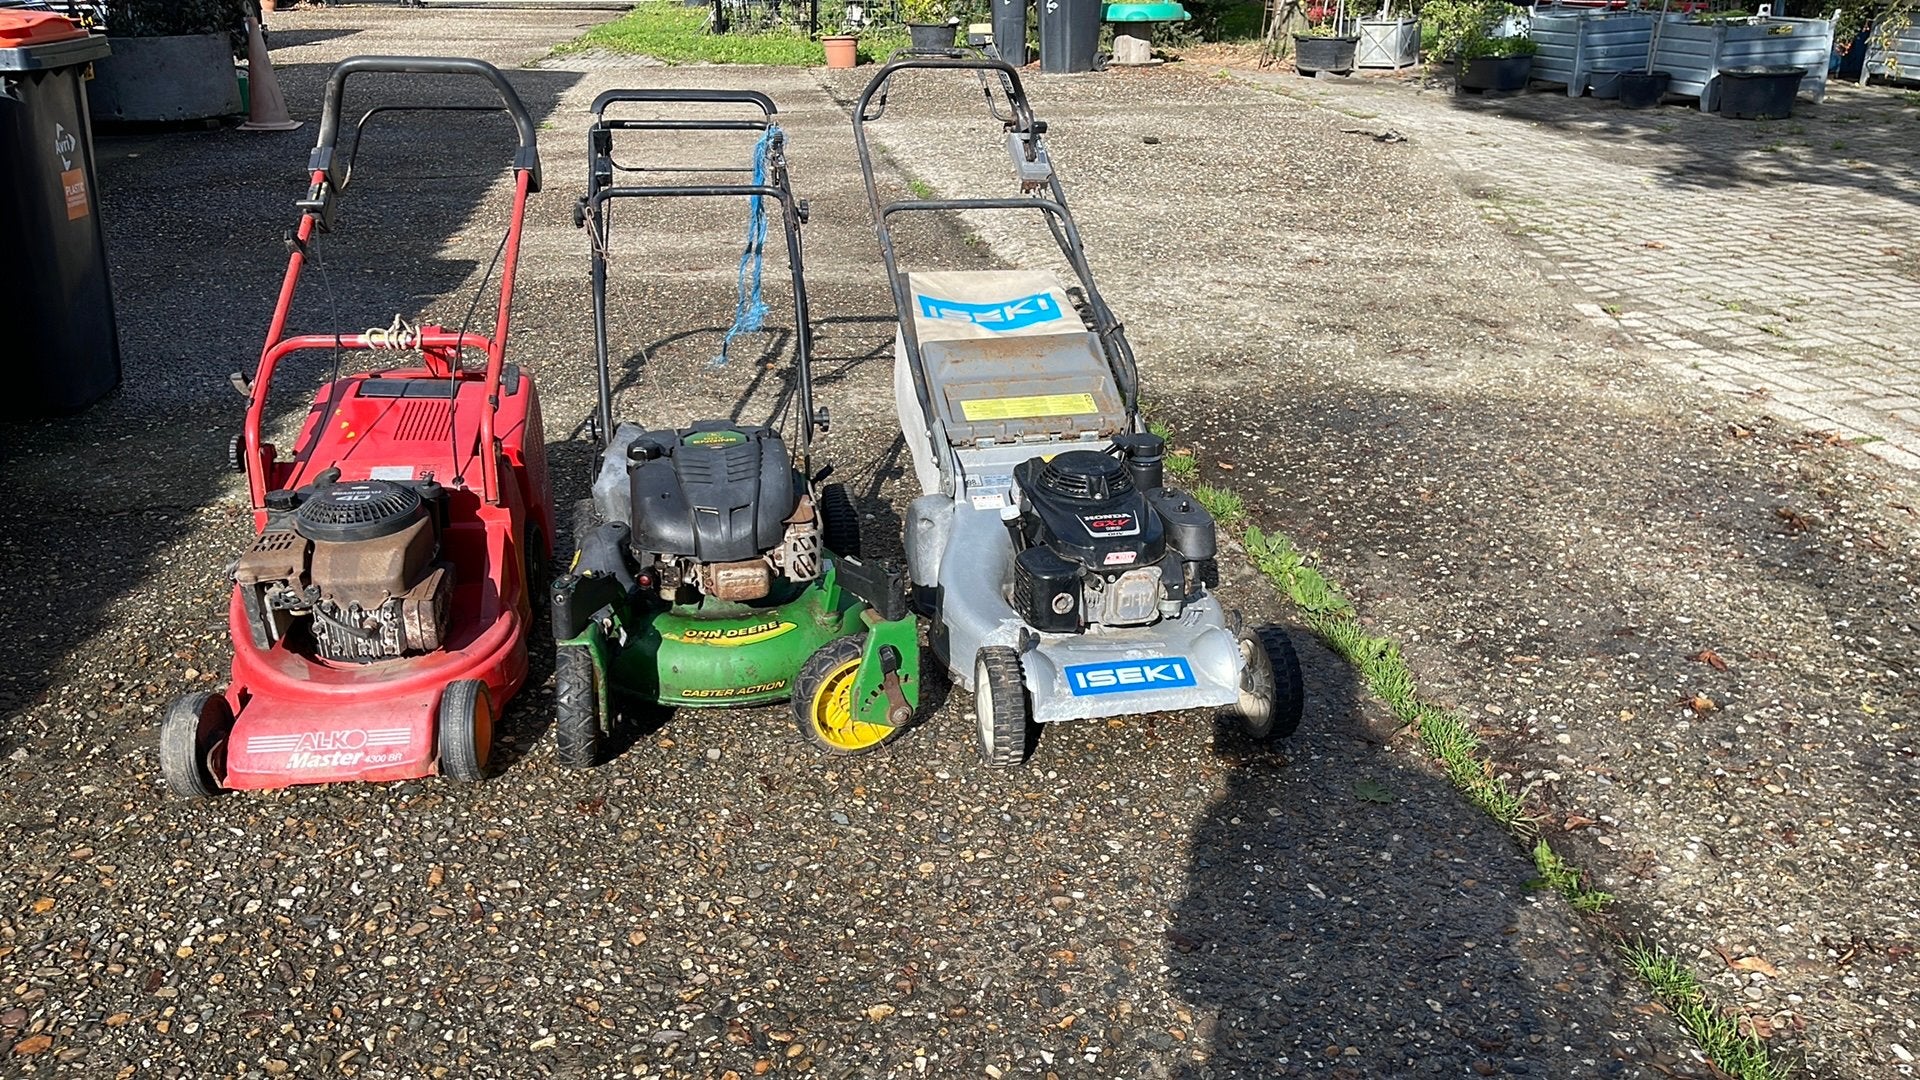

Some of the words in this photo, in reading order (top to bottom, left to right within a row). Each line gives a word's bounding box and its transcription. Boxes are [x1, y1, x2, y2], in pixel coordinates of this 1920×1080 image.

[928, 297, 1049, 323] ISEKI
[1083, 513, 1132, 521] HONDA
[1092, 519, 1131, 528] GXV
[726, 621, 778, 636] DEERE
[1075, 663, 1186, 689] ISEKI
[681, 689, 734, 697] CASTER
[736, 680, 786, 695] ACTION
[286, 751, 364, 769] Master
